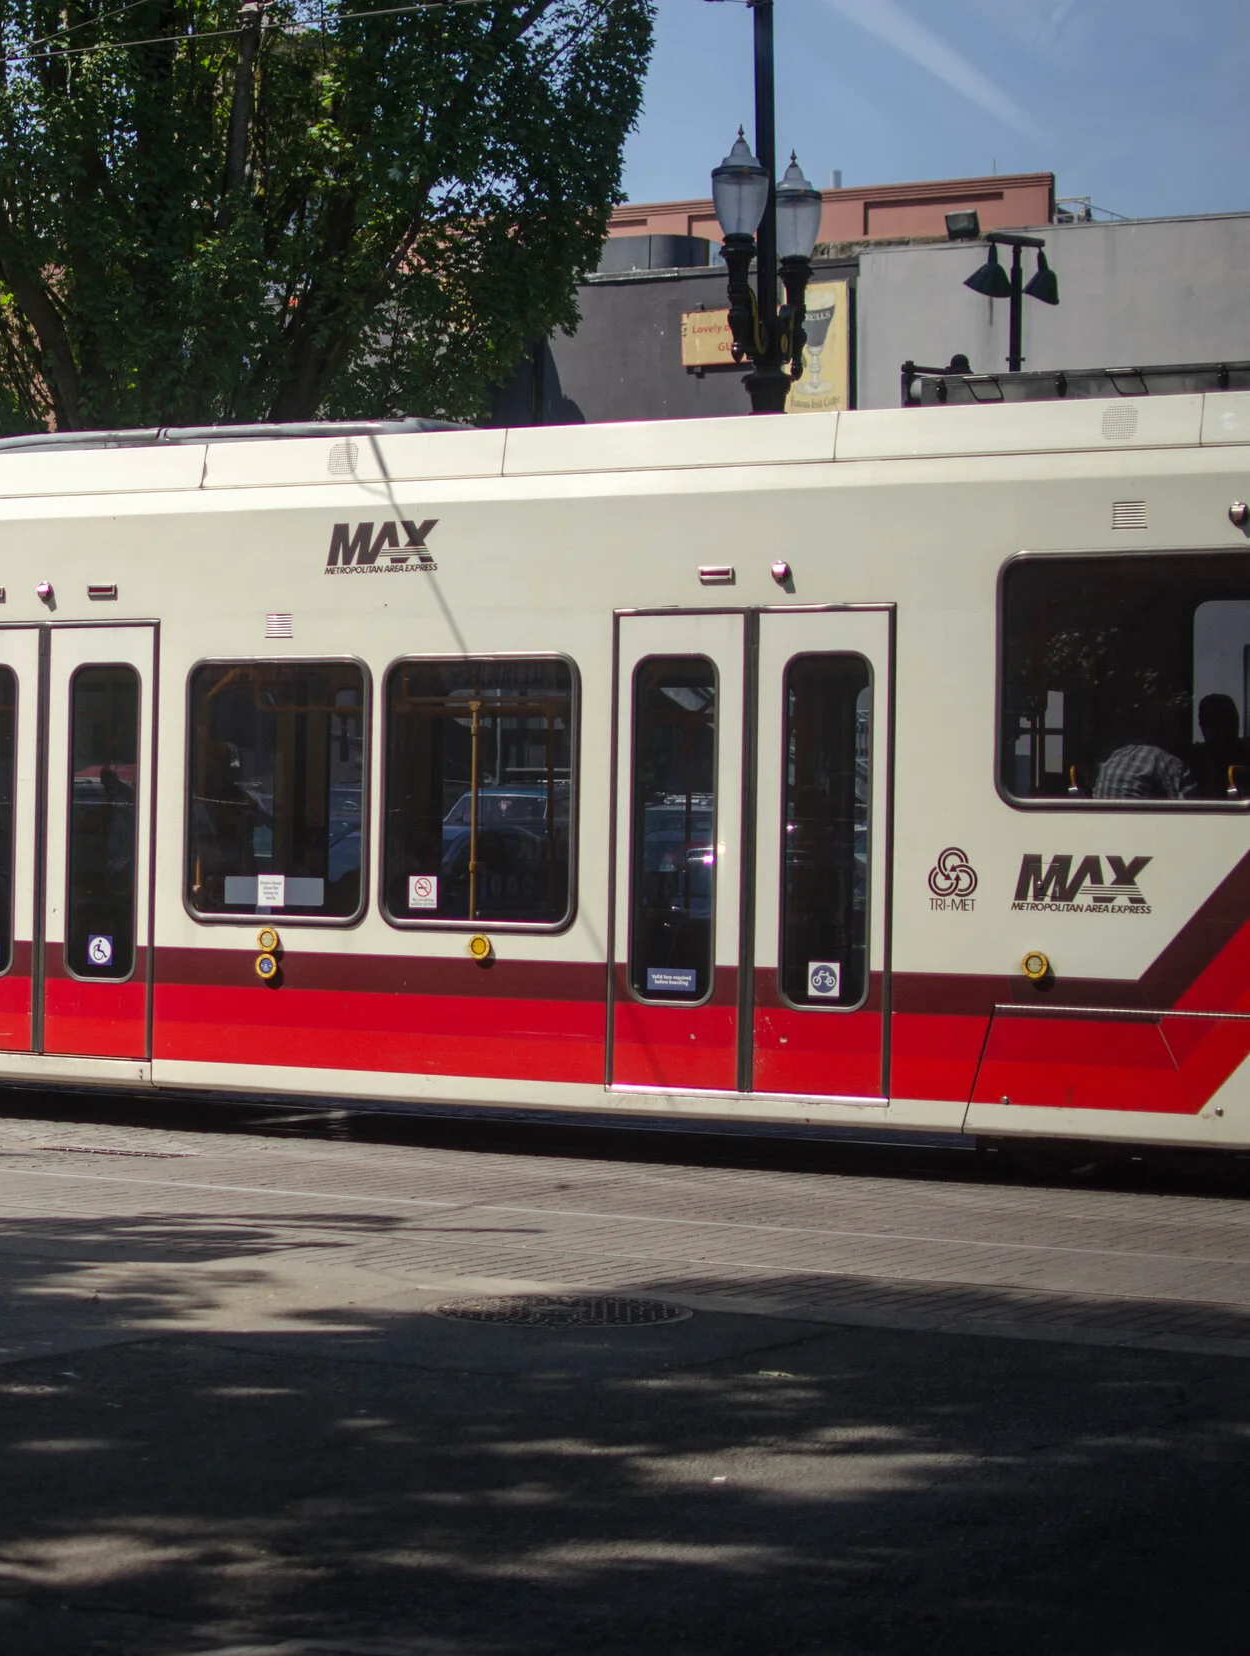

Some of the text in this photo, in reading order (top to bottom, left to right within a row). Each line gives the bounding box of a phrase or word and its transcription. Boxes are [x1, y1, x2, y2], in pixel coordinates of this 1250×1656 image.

[692, 323, 722, 334] Lovely
[326, 518, 440, 567] MAX
[324, 562, 438, 575] METROPOLITAN AREA EXPRESS
[1013, 853, 1154, 905] MAX
[929, 897, 977, 912] TRI-MET
[1010, 901, 1152, 915] METROPOLITAN AREA EXPRESS
